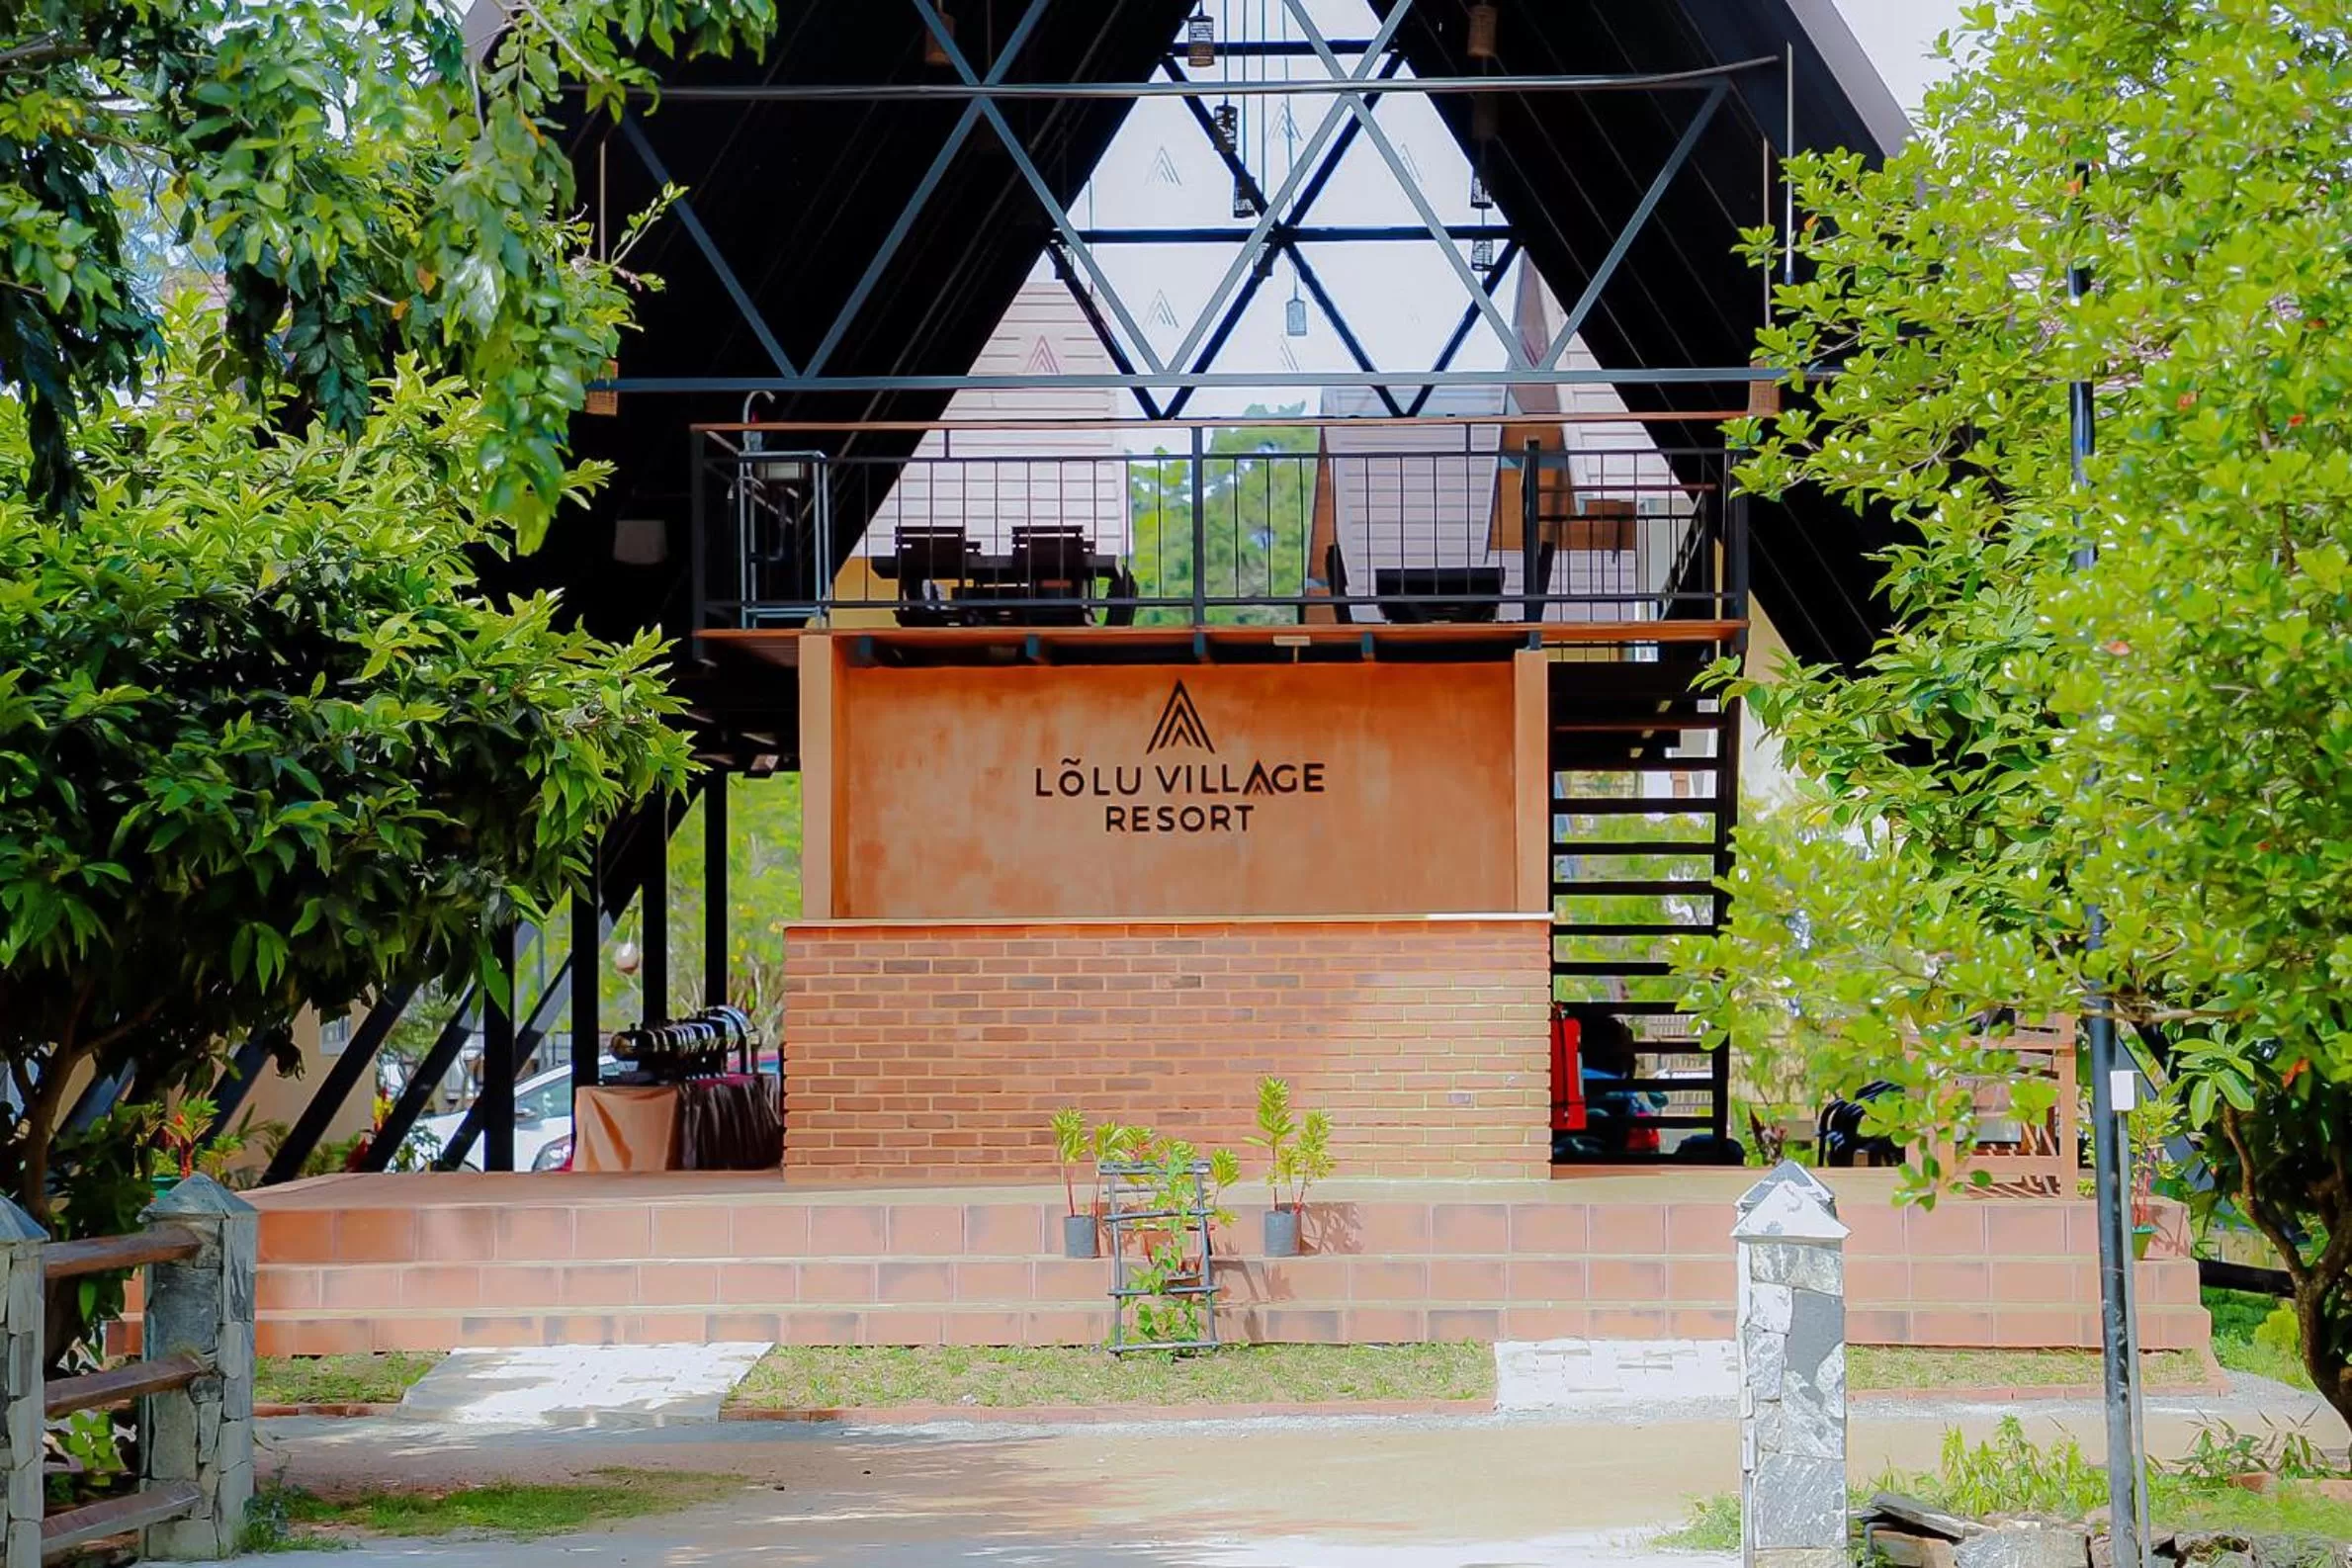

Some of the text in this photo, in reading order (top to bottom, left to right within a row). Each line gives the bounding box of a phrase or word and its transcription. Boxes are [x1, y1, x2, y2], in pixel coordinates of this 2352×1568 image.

[1035, 757, 1325, 797] LÕLU VILLAGE
[1105, 805, 1255, 832] RESORT
